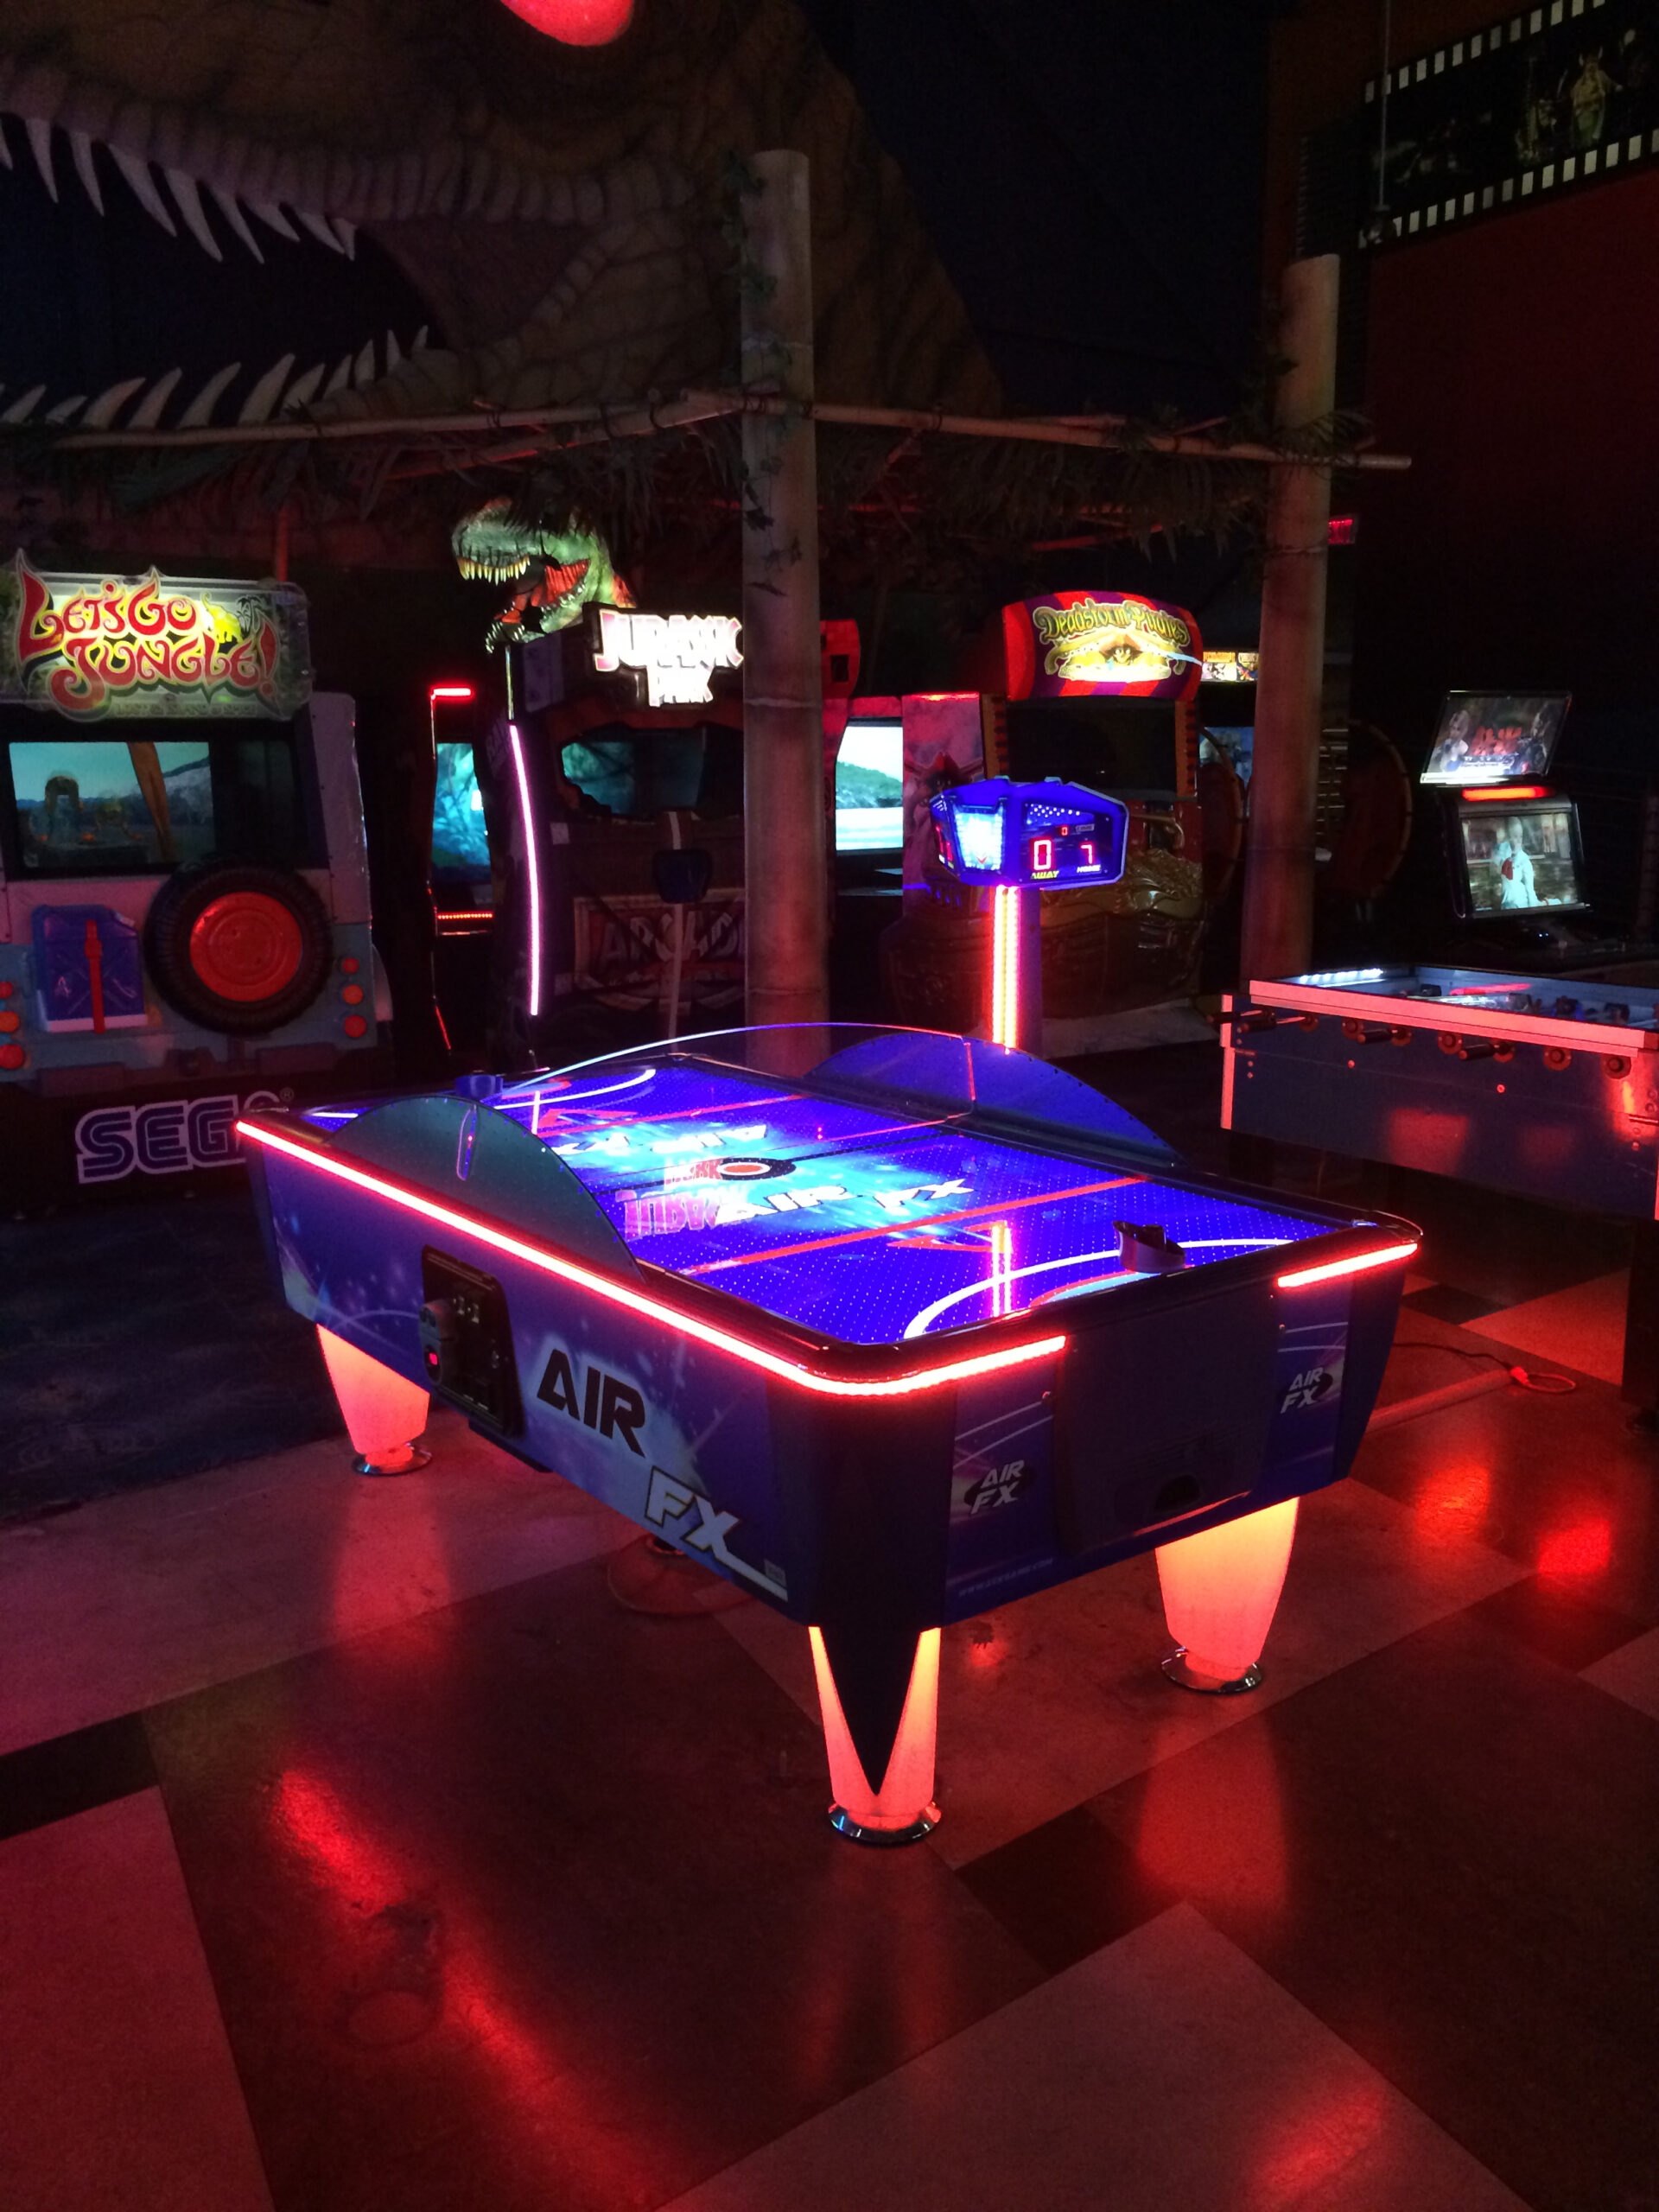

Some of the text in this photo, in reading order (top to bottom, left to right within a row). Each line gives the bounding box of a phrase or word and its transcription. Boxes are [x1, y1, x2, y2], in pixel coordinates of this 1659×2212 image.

[127, 574, 198, 637] GO
[1033, 839, 1052, 871] 0
[1030, 870, 1060, 880] AWAY
[75, 1090, 281, 1184] SEG
[1288, 1367, 1324, 1392] AIR
[537, 1348, 646, 1459] AIR
[1280, 1385, 1319, 1414] FX
[980, 1459, 1026, 1490] AIR
[970, 1480, 1020, 1515] FX
[644, 1465, 789, 1603] FX
